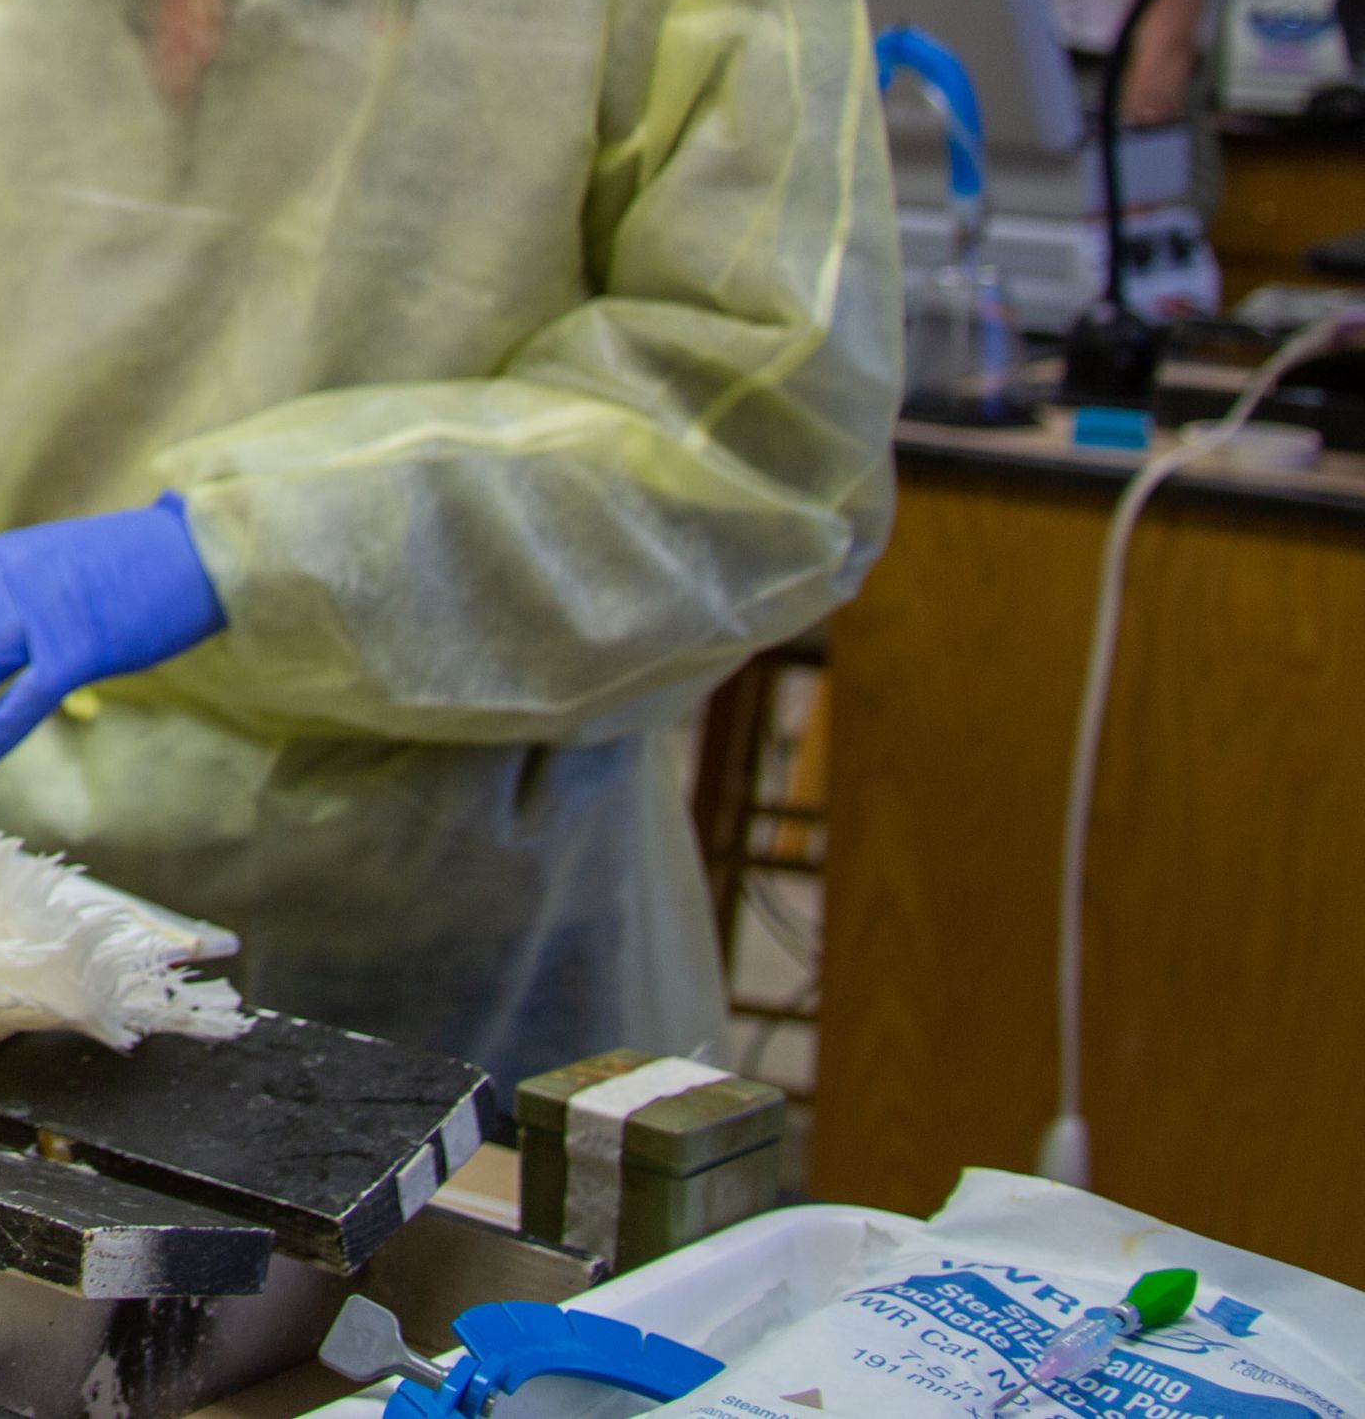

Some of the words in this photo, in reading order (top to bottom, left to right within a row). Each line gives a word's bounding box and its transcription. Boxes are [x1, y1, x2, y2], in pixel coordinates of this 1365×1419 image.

[893, 1285, 1012, 1350] ochette
[900, 1348, 952, 1380] 7.5
[919, 1329, 980, 1365] Cat.
[852, 1347, 902, 1375] 191
[906, 1372, 963, 1402] mm
[1102, 1359, 1192, 1403] aling
